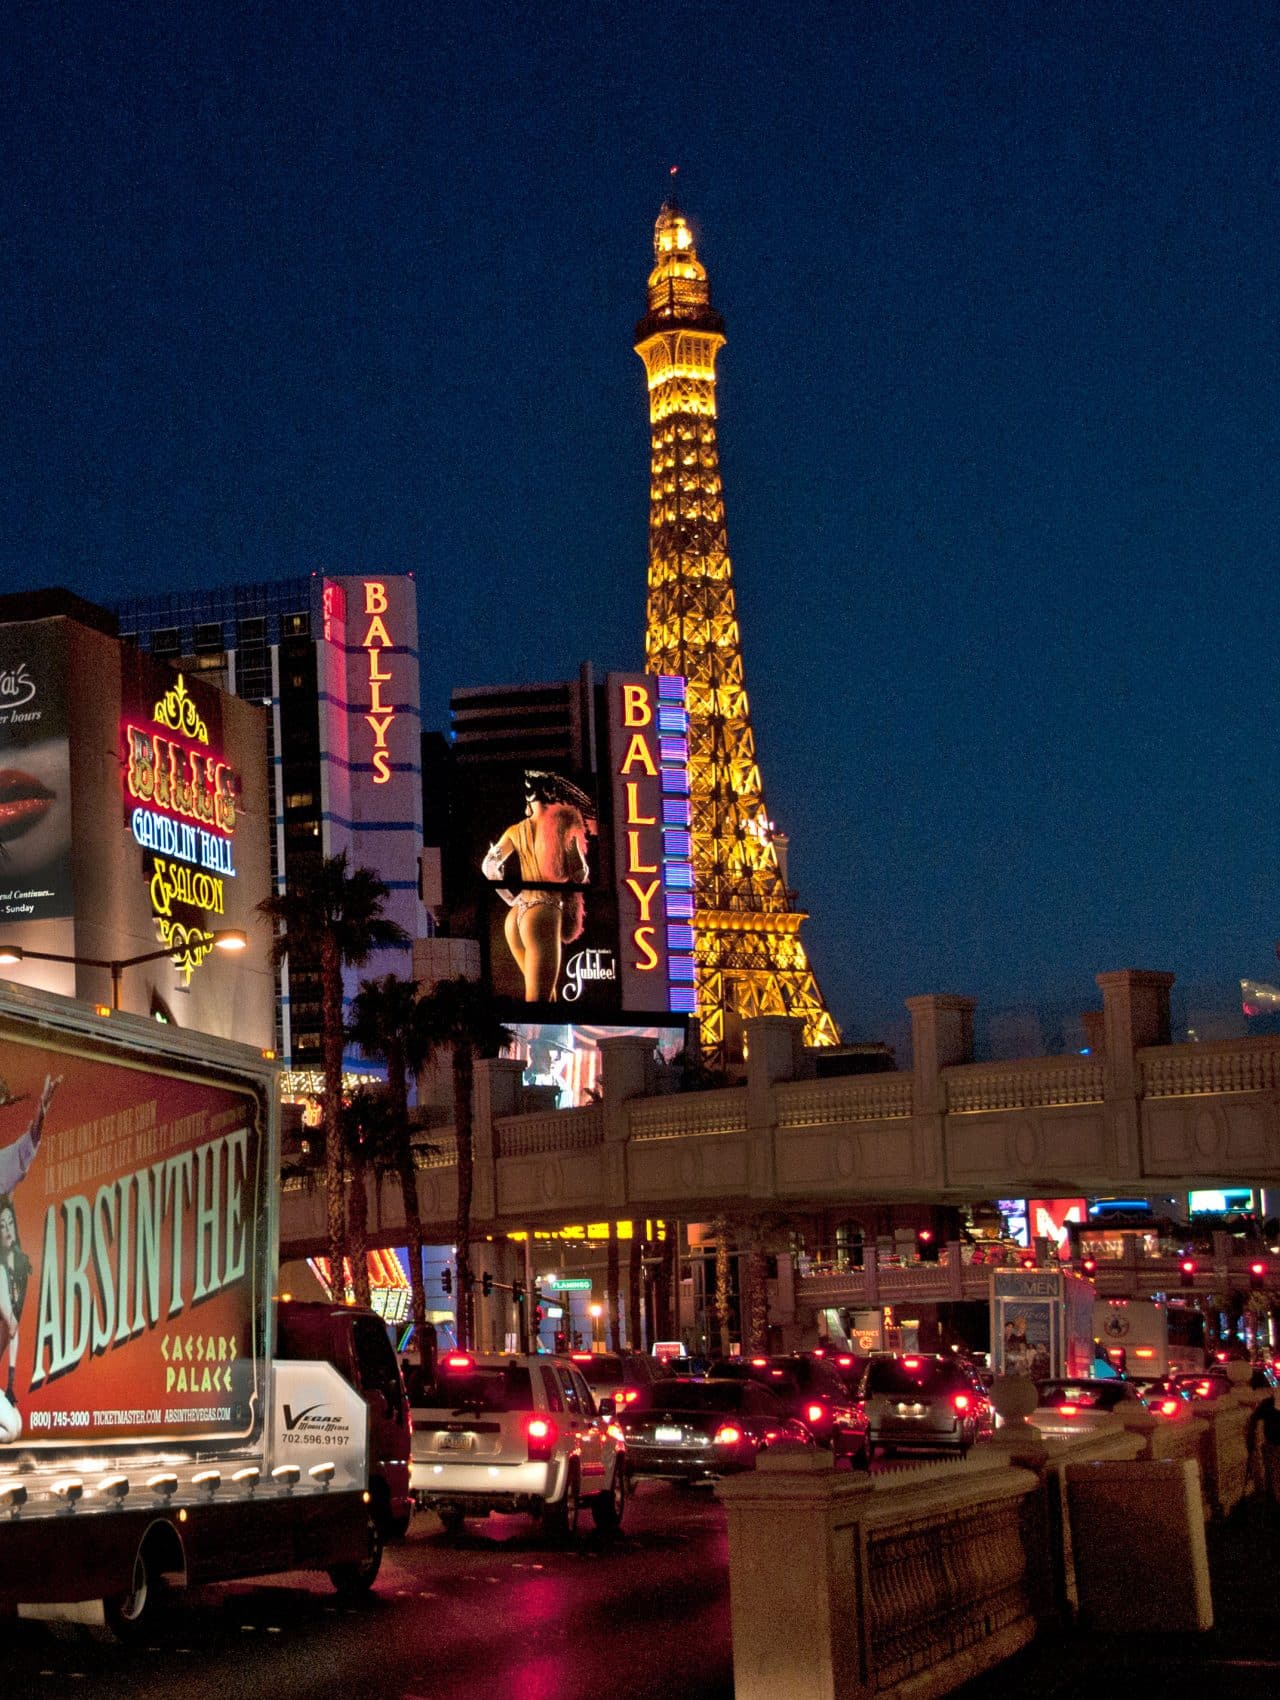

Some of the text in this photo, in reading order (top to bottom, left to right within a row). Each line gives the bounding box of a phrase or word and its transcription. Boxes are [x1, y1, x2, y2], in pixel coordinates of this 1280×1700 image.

[363, 582, 395, 784] BALLYS
[11, 710, 42, 724] hours
[128, 725, 236, 834] BILL'S
[132, 807, 236, 877] GAMBLIN' HALL
[620, 685, 661, 970] BALLYS
[151, 857, 225, 916] & SALOON
[5, 902, 35, 916] Sunday
[562, 948, 616, 1002] Jubilee!
[32, 1127, 249, 1384] ABSINTHE
[552, 1281, 590, 1289] FLAMINGO
[161, 1335, 237, 1362] CAESARS
[166, 1366, 232, 1393] PALACE
[30, 1411, 51, 1430] (800)
[53, 1410, 90, 1427] 745-3000
[93, 1408, 161, 1426] TICKETMASTER.COM
[282, 1433, 349, 1446] 702.596.9197
